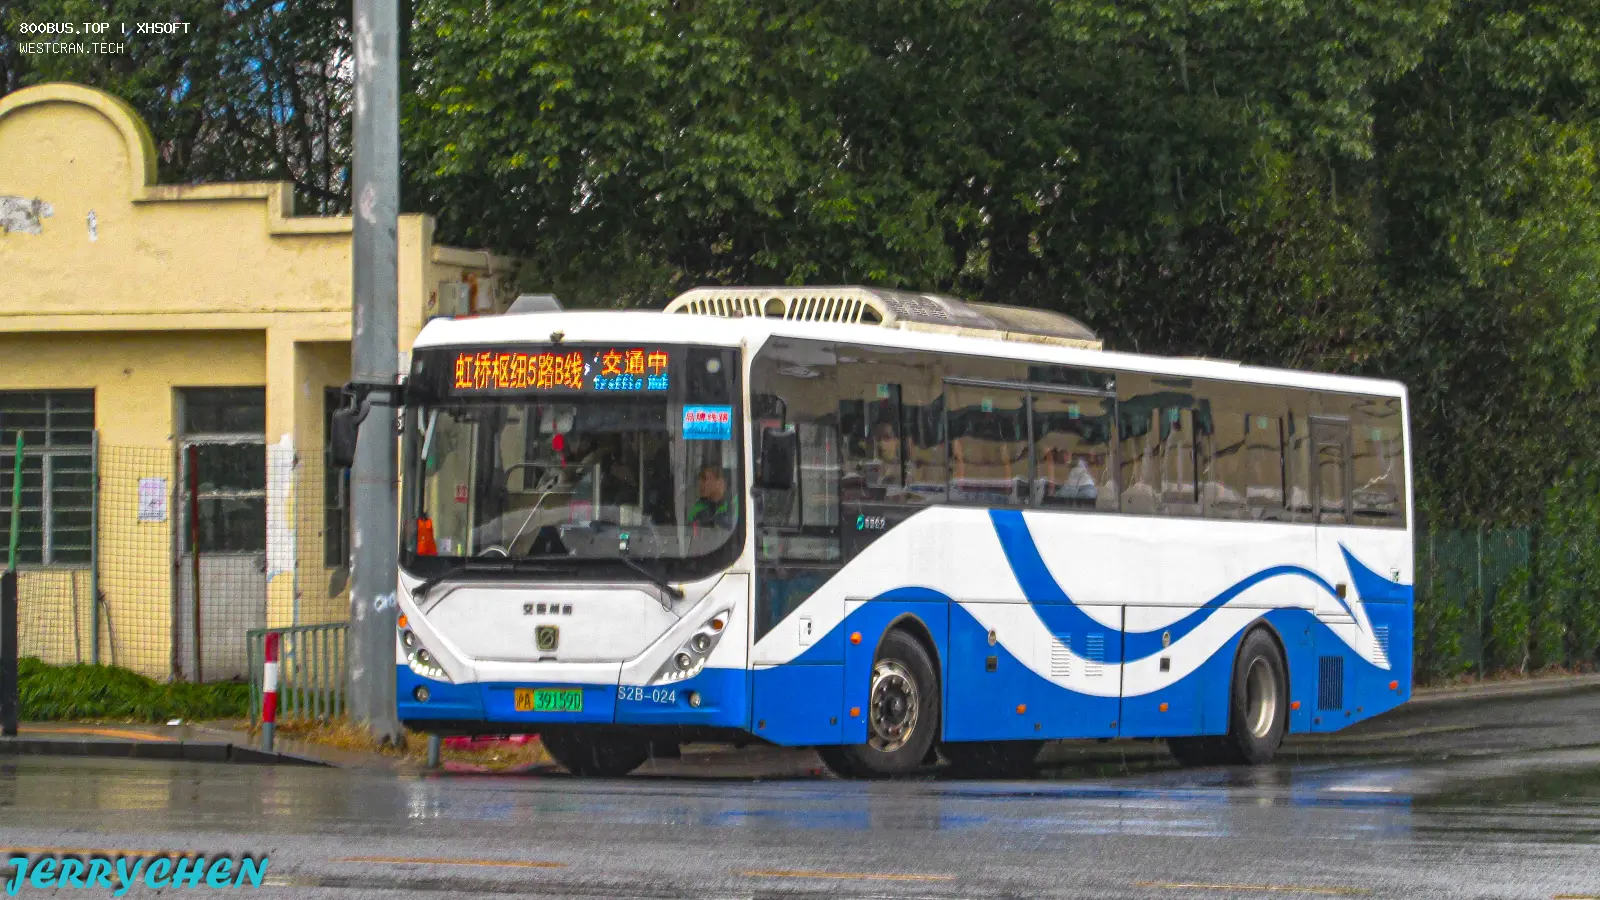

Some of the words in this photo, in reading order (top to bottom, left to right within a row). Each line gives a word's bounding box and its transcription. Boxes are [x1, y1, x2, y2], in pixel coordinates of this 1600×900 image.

[454, 352, 583, 389] 虹桥枢纽5路B线
[600, 348, 669, 376] 交通中
[617, 685, 676, 704] S2B-024
